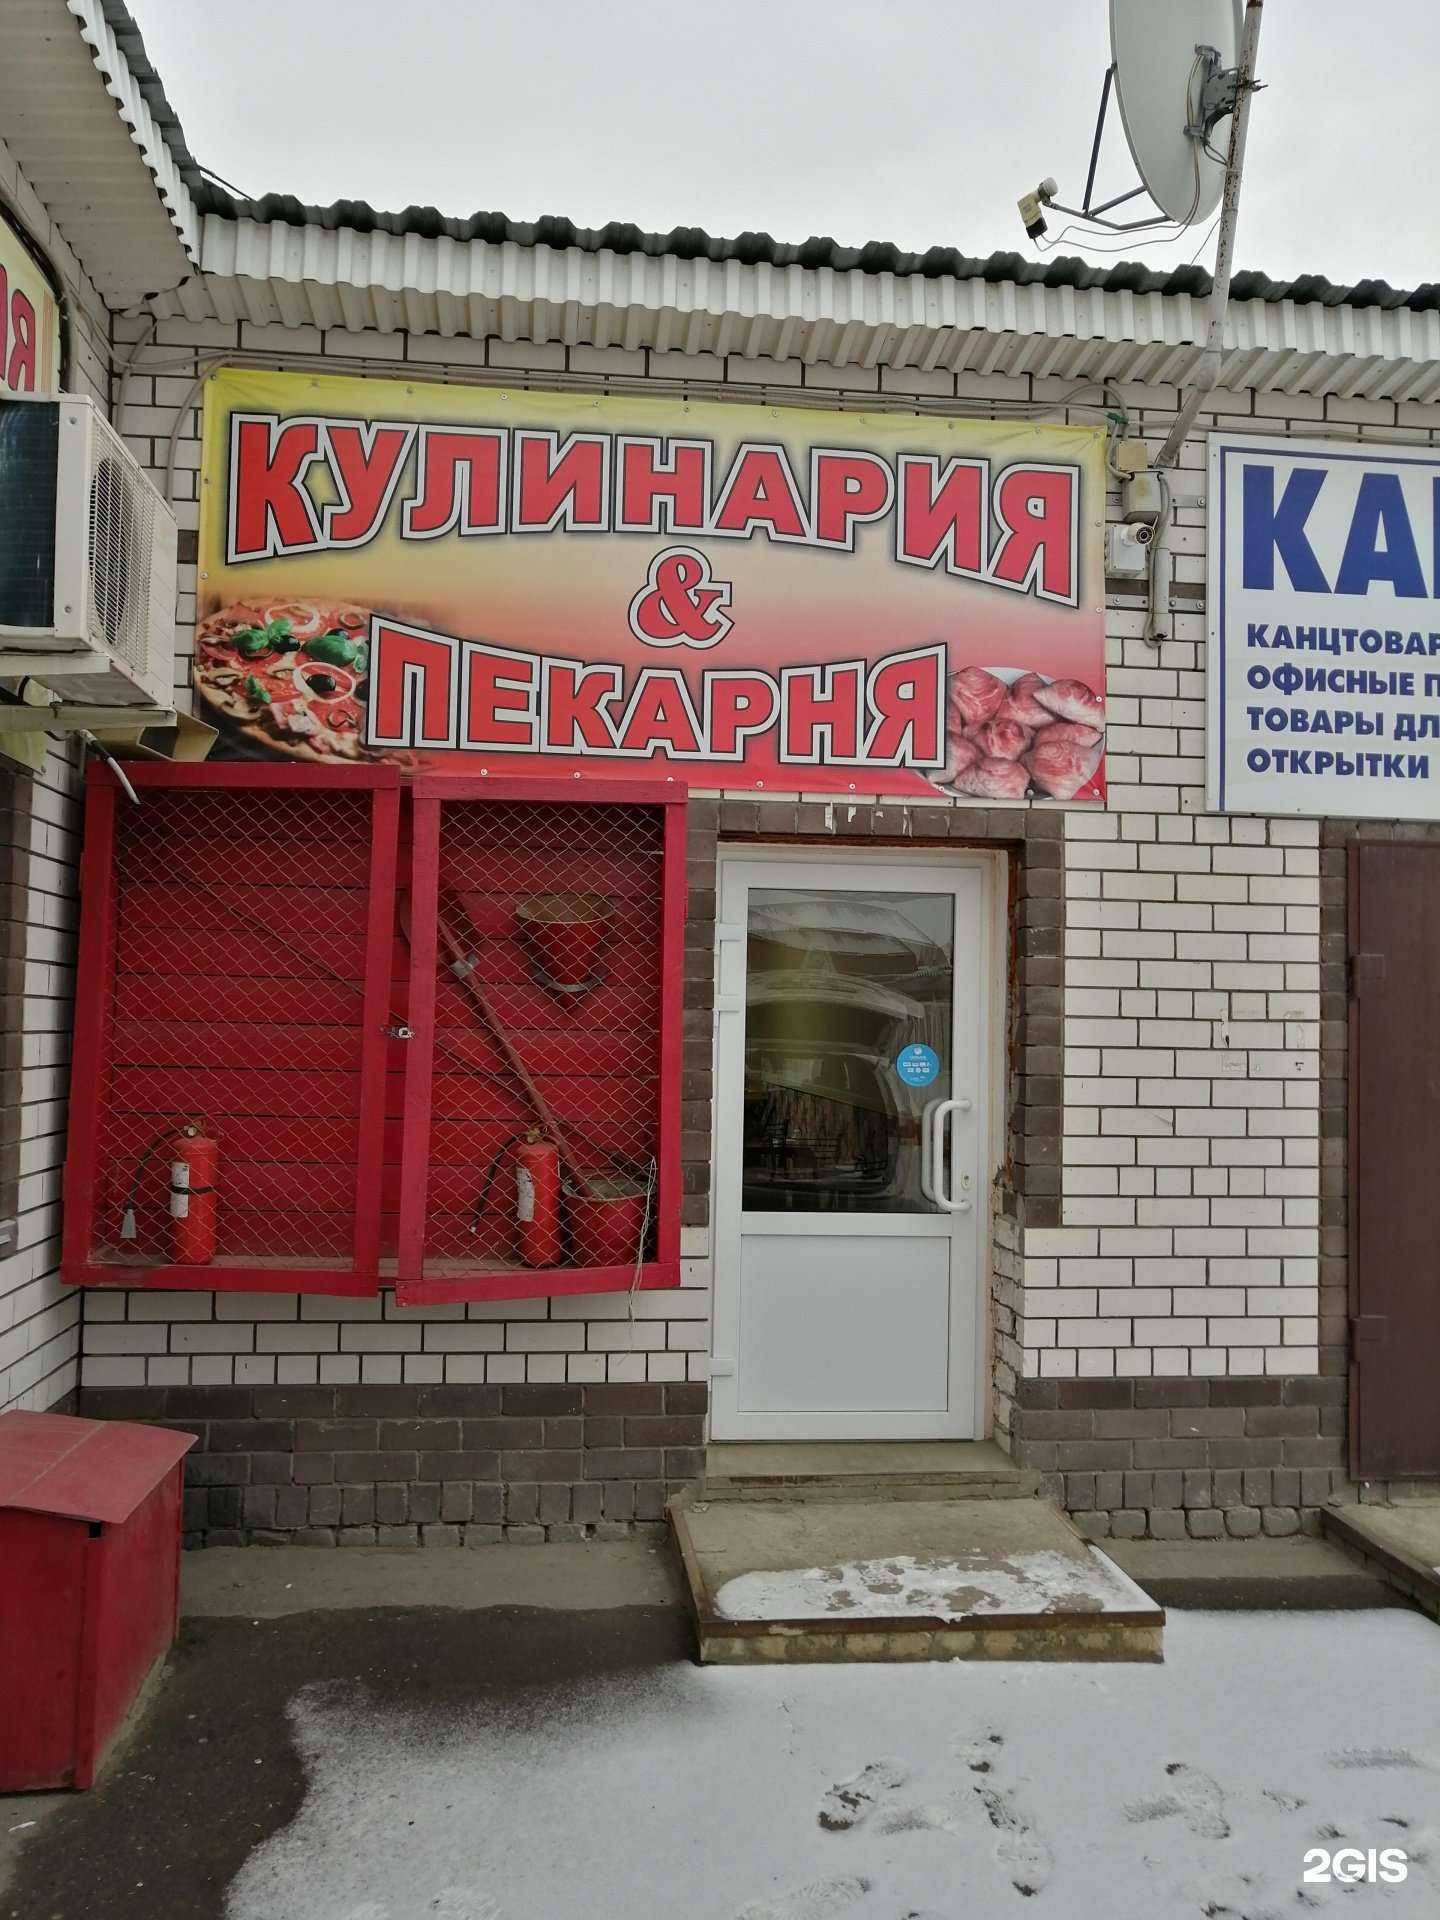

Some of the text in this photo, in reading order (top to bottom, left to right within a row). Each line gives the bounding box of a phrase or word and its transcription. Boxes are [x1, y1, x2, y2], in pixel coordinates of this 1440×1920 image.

[226, 411, 1080, 608] КУЛИНАРИЯ
[1243, 464, 1440, 599] КА
[629, 545, 733, 649] &
[367, 613, 947, 769] ПЕКАРНЯ
[1246, 707, 1384, 736] ТОВАРЫ
[1247, 662, 1415, 696] ОФИСНЫЕ
[1246, 748, 1429, 779] ОТКРЫТКИ
